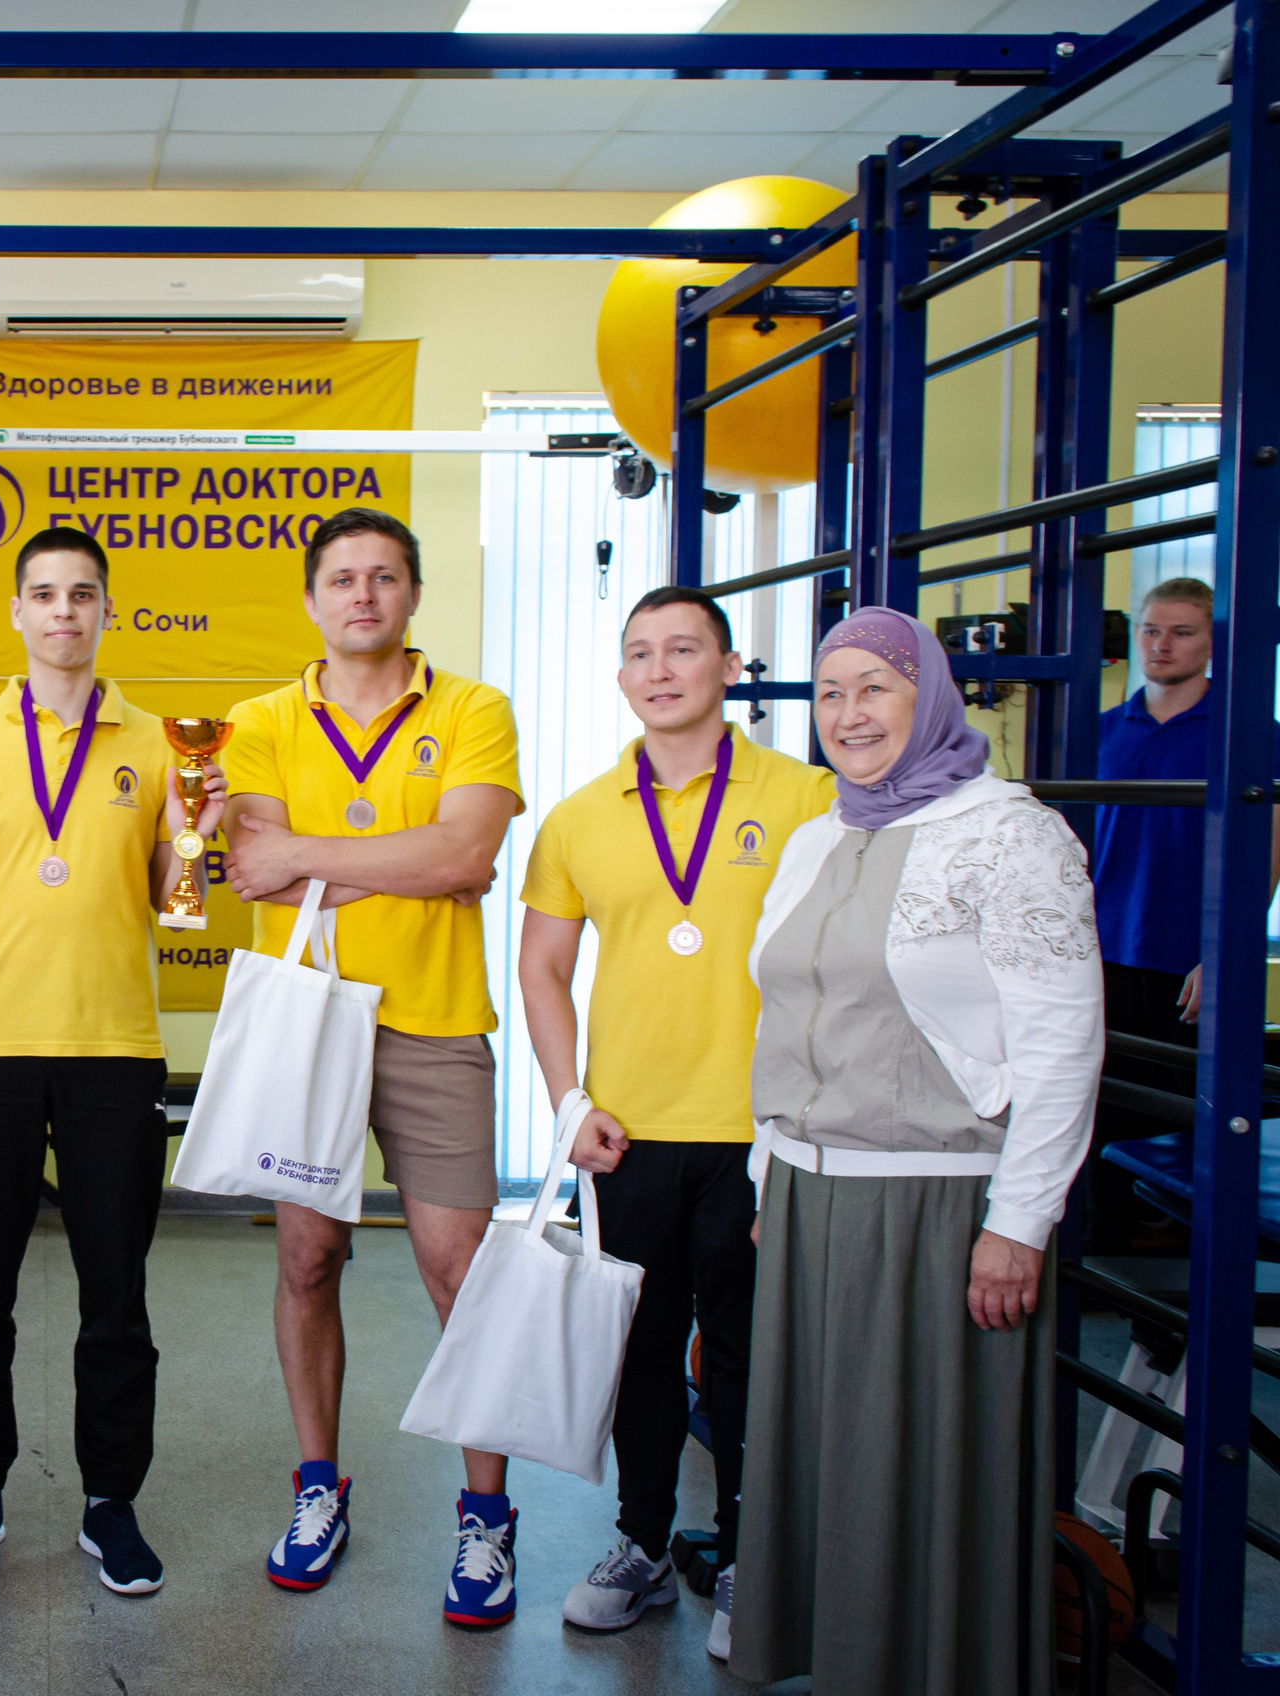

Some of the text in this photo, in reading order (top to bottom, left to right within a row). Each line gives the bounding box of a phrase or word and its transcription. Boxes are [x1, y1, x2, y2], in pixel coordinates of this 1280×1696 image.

[152, 377, 168, 395] в
[178, 377, 333, 399] движении
[49, 466, 382, 505] ЦЕНТР ДОКТОРА
[133, 607, 208, 632] Сочи
[277, 1167, 339, 1185] БУБНОВСКОГО
[280, 1157, 340, 1175] ЦЕНТР ДОКТОРА
